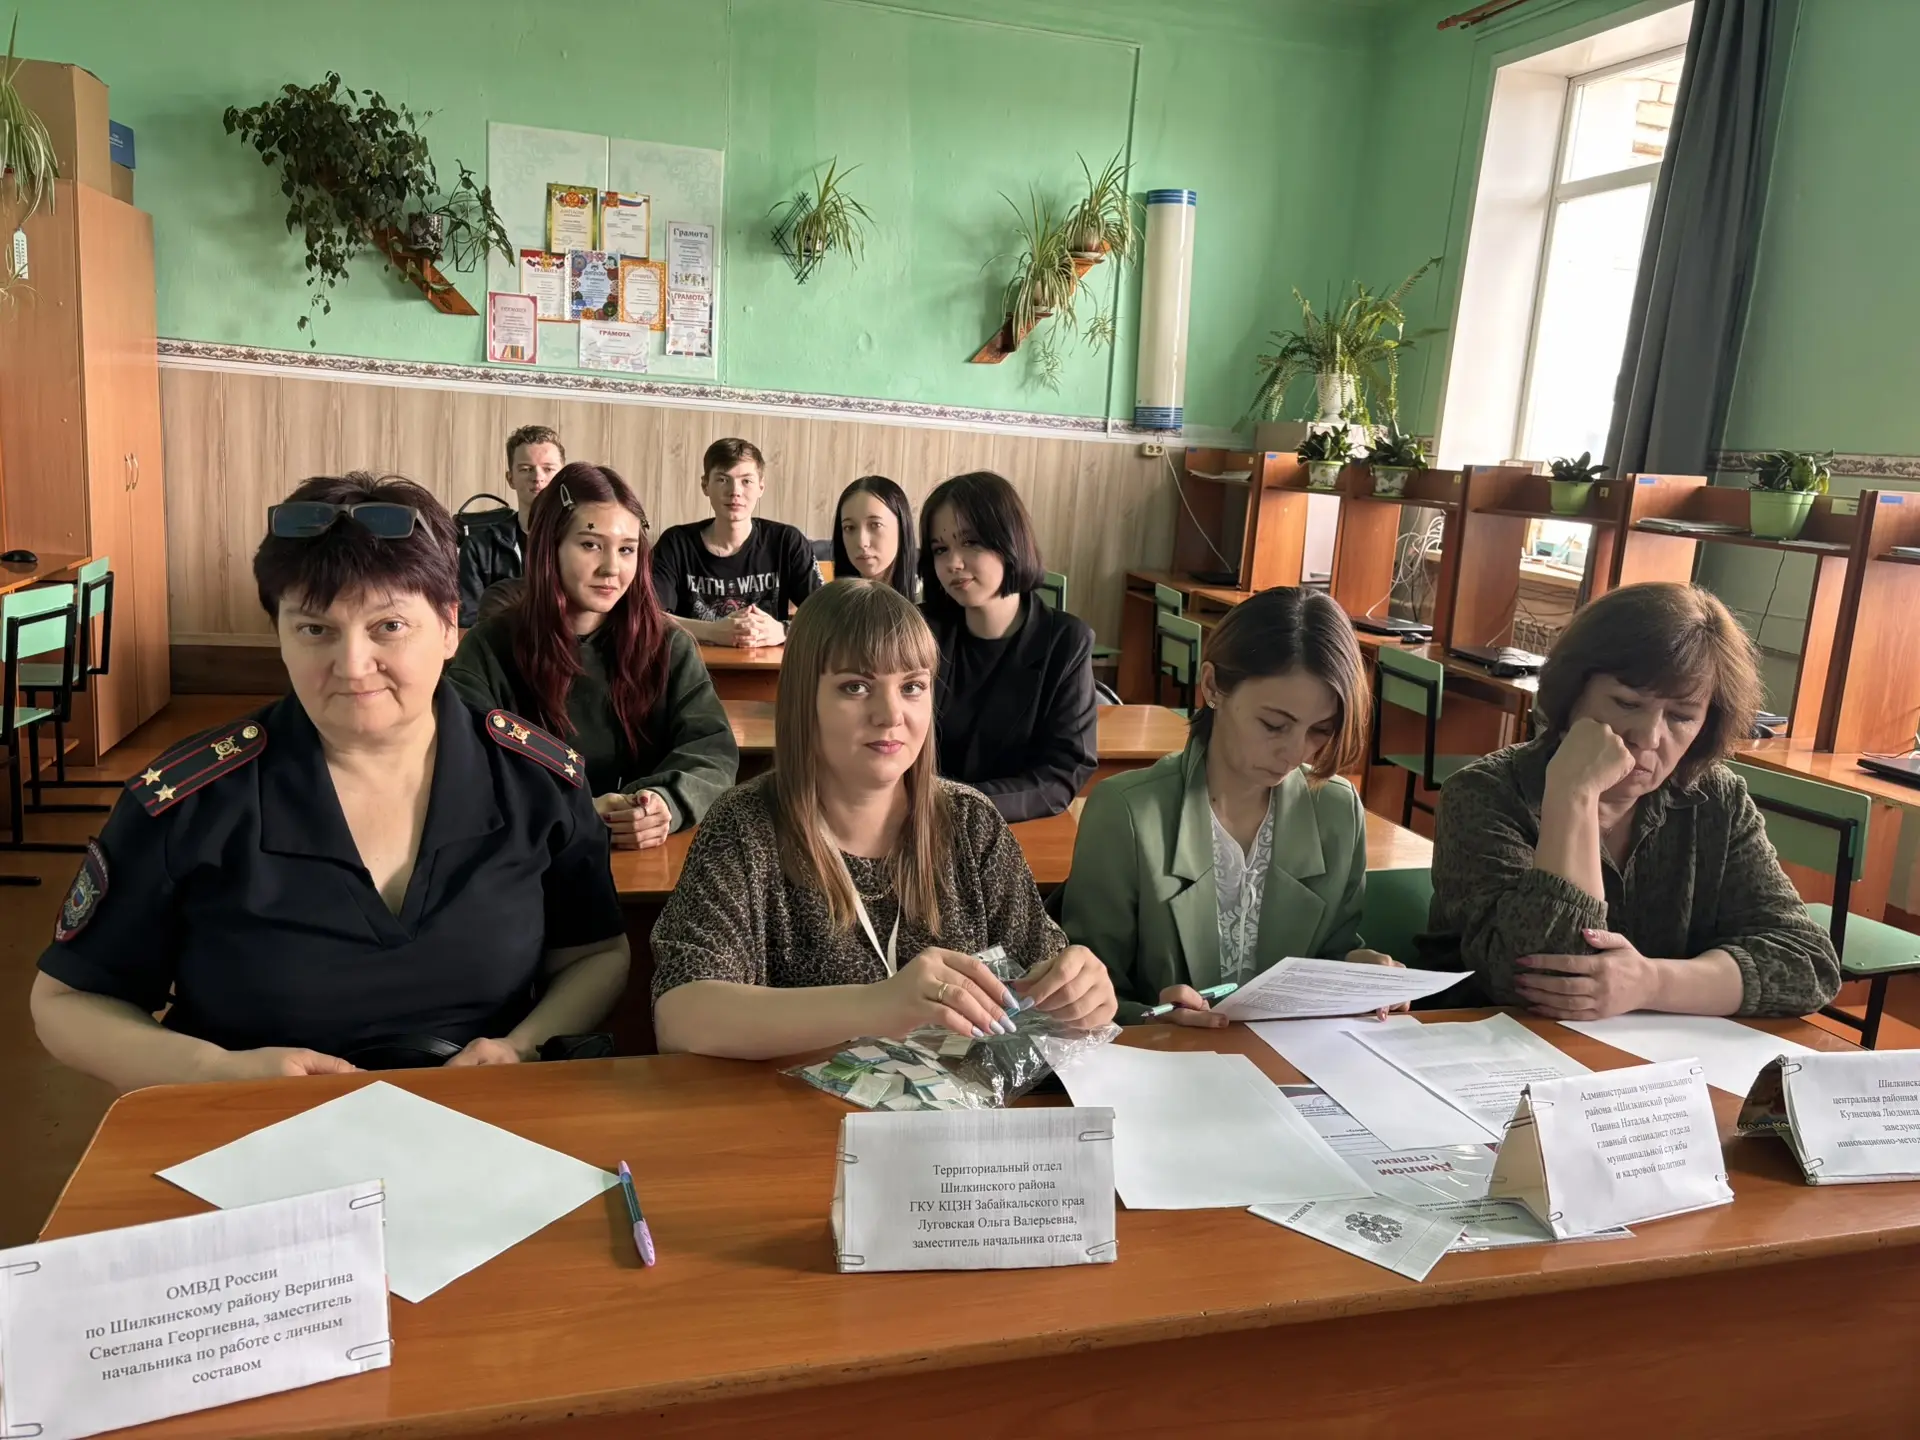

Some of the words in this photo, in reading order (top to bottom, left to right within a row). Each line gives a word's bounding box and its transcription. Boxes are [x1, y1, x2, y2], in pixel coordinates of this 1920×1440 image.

[673, 227, 709, 238] Грамота
[674, 292, 705, 301] ГРАМОТА
[599, 330, 631, 338] ГРАМОТА
[1580, 1085, 1638, 1102] Администрация
[1638, 1077, 1693, 1094] муниципального
[1832, 1095, 1881, 1106] центральная
[1881, 1093, 1918, 1104] районная
[1584, 1106, 1612, 1119] района
[1839, 1109, 1881, 1120] Кузнецова
[1590, 1121, 1620, 1133] Панина
[1620, 1116, 1651, 1128] Наталья
[1596, 1135, 1628, 1149] главный
[1628, 1129, 1668, 1144] специалист
[1669, 1125, 1691, 1136] отдела
[1371, 1155, 1431, 1166] СТЕПЕНИ
[1606, 1144, 1664, 1165] муниципальной
[1663, 1139, 1688, 1155] службы
[933, 1160, 1030, 1177] Территориальный
[1032, 1161, 1063, 1173] отдел
[1377, 1161, 1455, 1176] ДИПЛОМ
[1615, 1171, 1621, 1179] и
[1621, 1162, 1656, 1178] кадровой
[1657, 1158, 1687, 1171] политики
[940, 1181, 1016, 1194] Шилкинского
[1018, 1179, 1056, 1193] района
[909, 1200, 935, 1213] ГКУ
[938, 1200, 972, 1214] КЦЗН
[974, 1196, 1059, 1211] Забайкальского
[1061, 1197, 1085, 1209] края
[917, 1217, 975, 1233] Луговская
[977, 1216, 1010, 1229] Ольга
[1013, 1213, 1078, 1228] Валерьевна,
[912, 1237, 980, 1249] заместитель
[982, 1234, 1045, 1247] начальника
[1047, 1231, 1083, 1244] отдела
[166, 1276, 222, 1301] ОМВД
[225, 1267, 279, 1290] России
[85, 1325, 106, 1340] по
[110, 1300, 224, 1336] Шилкинскому
[227, 1286, 281, 1314] району
[284, 1271, 354, 1298] Веригина
[89, 1334, 164, 1361] Светлана
[168, 1314, 261, 1346] Георгиевна,
[263, 1295, 353, 1325] заместитель
[102, 1351, 193, 1382] начальника
[196, 1347, 216, 1363] по
[219, 1334, 270, 1362] работе
[273, 1331, 281, 1343] с
[285, 1316, 344, 1342] личным
[191, 1357, 262, 1384] составом
